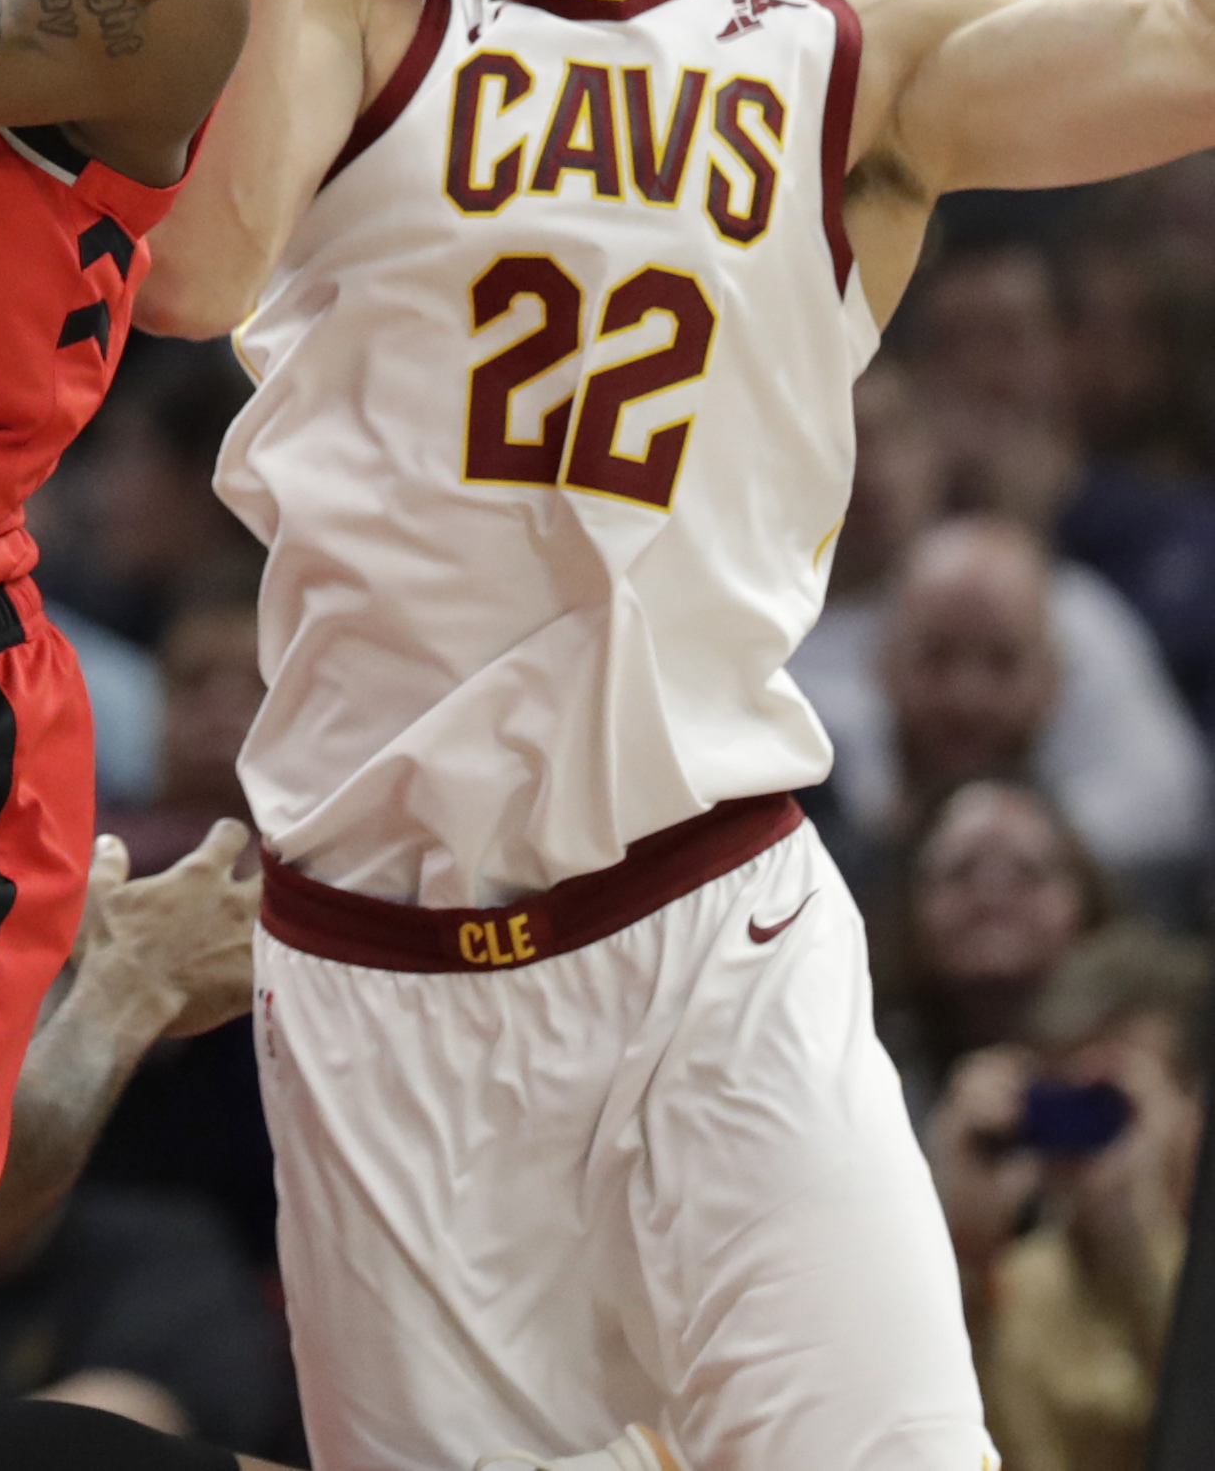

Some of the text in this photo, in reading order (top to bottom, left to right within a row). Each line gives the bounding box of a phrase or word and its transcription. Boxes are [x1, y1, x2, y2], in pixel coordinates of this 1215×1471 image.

[442, 48, 787, 249] CAVS
[459, 251, 720, 515] 22
[458, 912, 537, 965] CLE
